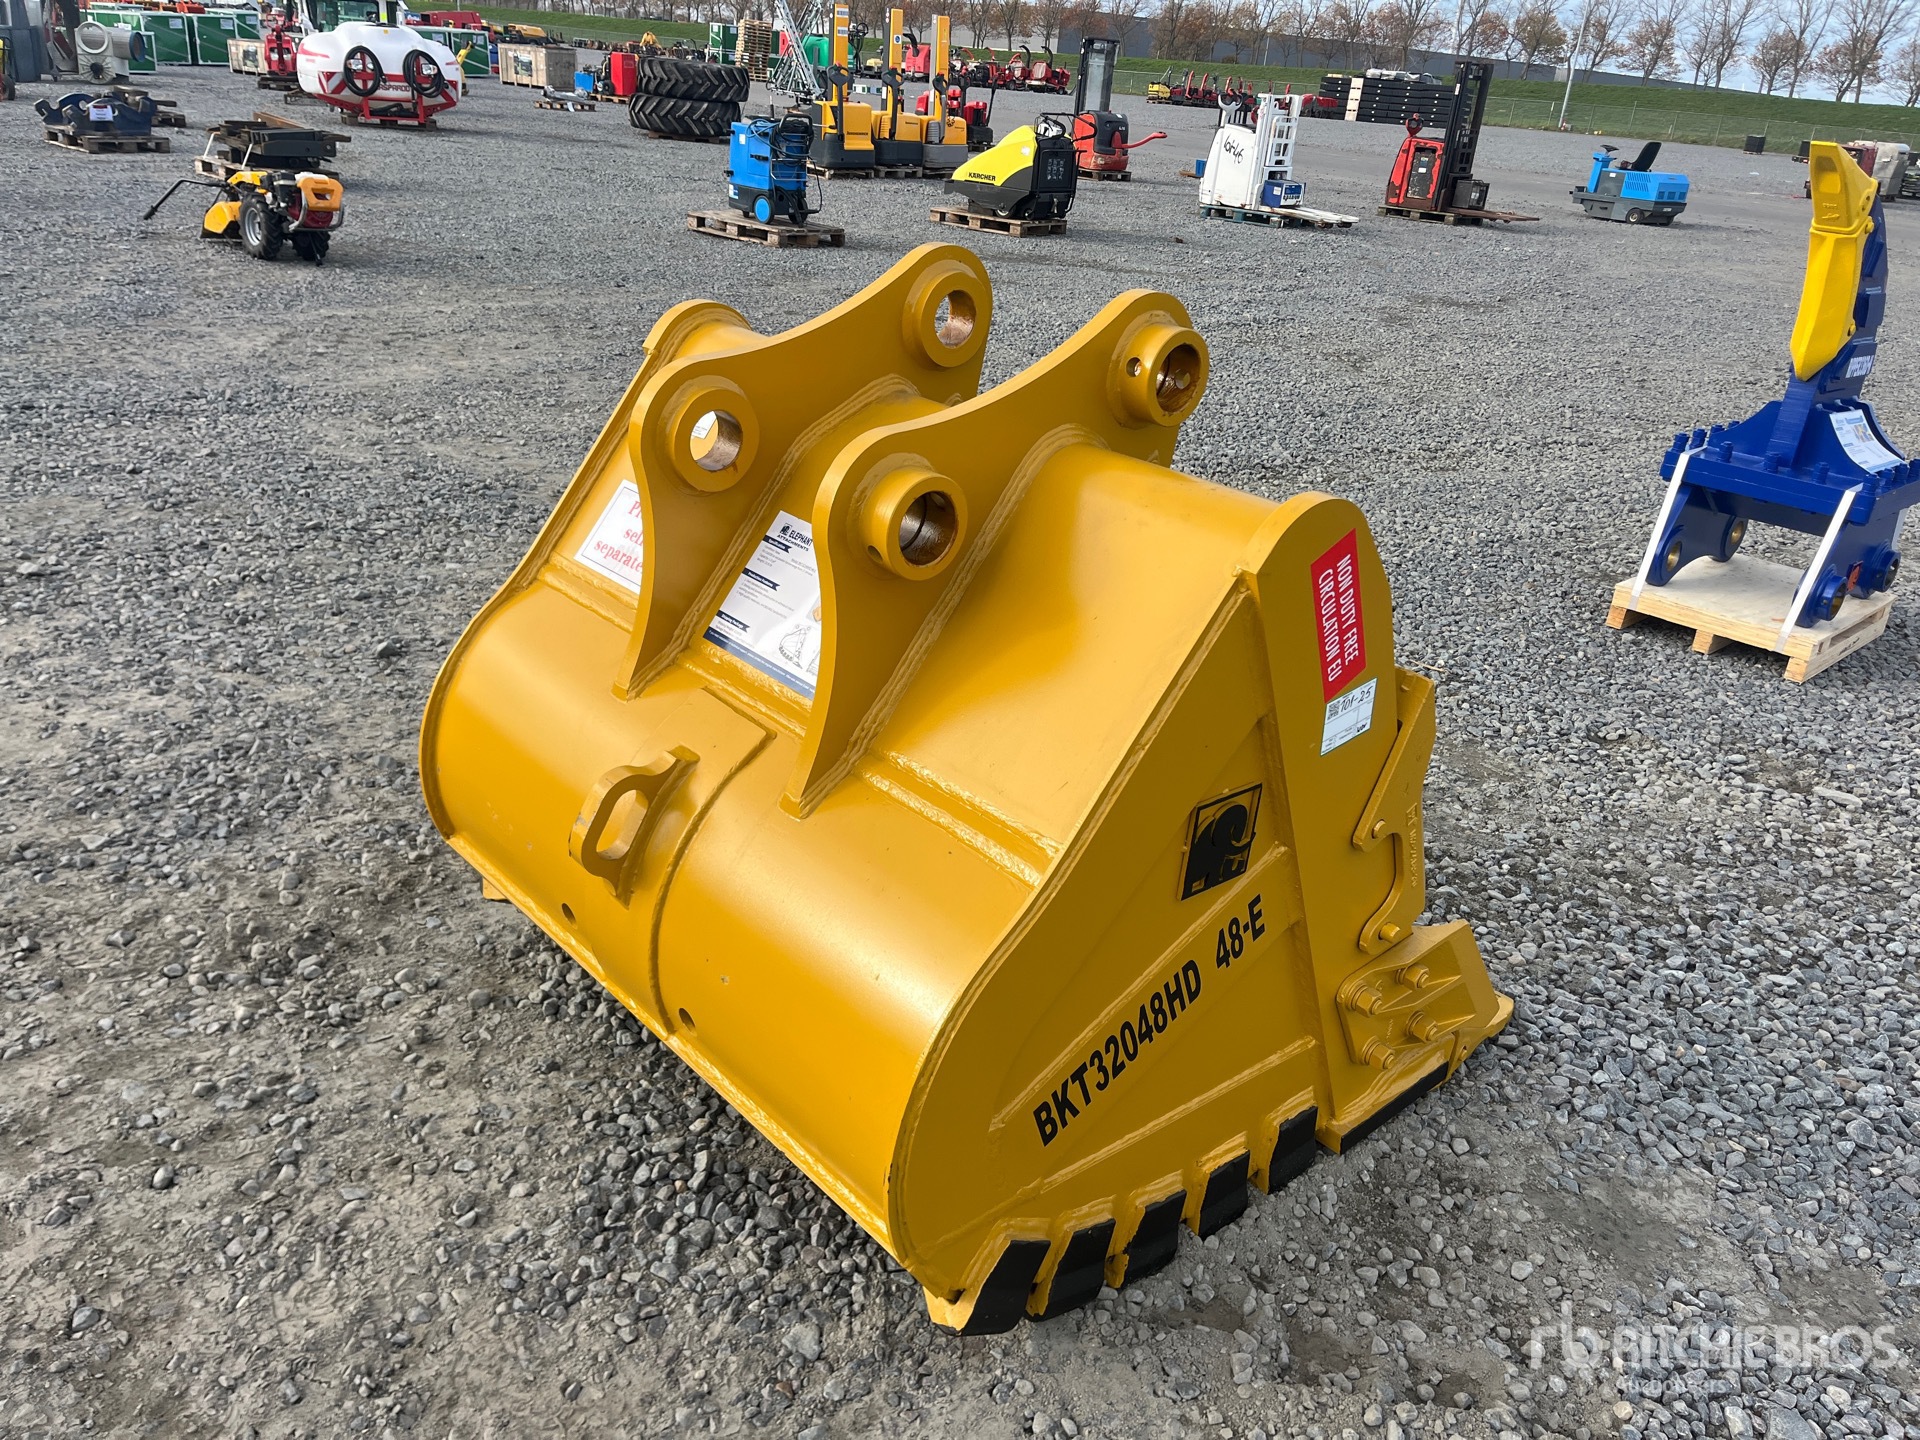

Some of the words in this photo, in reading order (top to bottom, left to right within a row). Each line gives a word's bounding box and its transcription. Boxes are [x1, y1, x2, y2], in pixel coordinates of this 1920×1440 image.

[377, 83, 411, 92] ASPARDO
[776, 534, 809, 552] ATTACHMENTS
[788, 529, 813, 547] ELEPHANT
[594, 540, 643, 574] separate
[1337, 554, 1353, 592] NON
[1318, 568, 1341, 662] CIRCULATION
[1339, 588, 1356, 629] DUTY
[1343, 627, 1359, 666] FREE
[1327, 658, 1343, 682] EU
[1032, 959, 1202, 1147] BKT32048HD
[1215, 894, 1266, 970] 48-E
